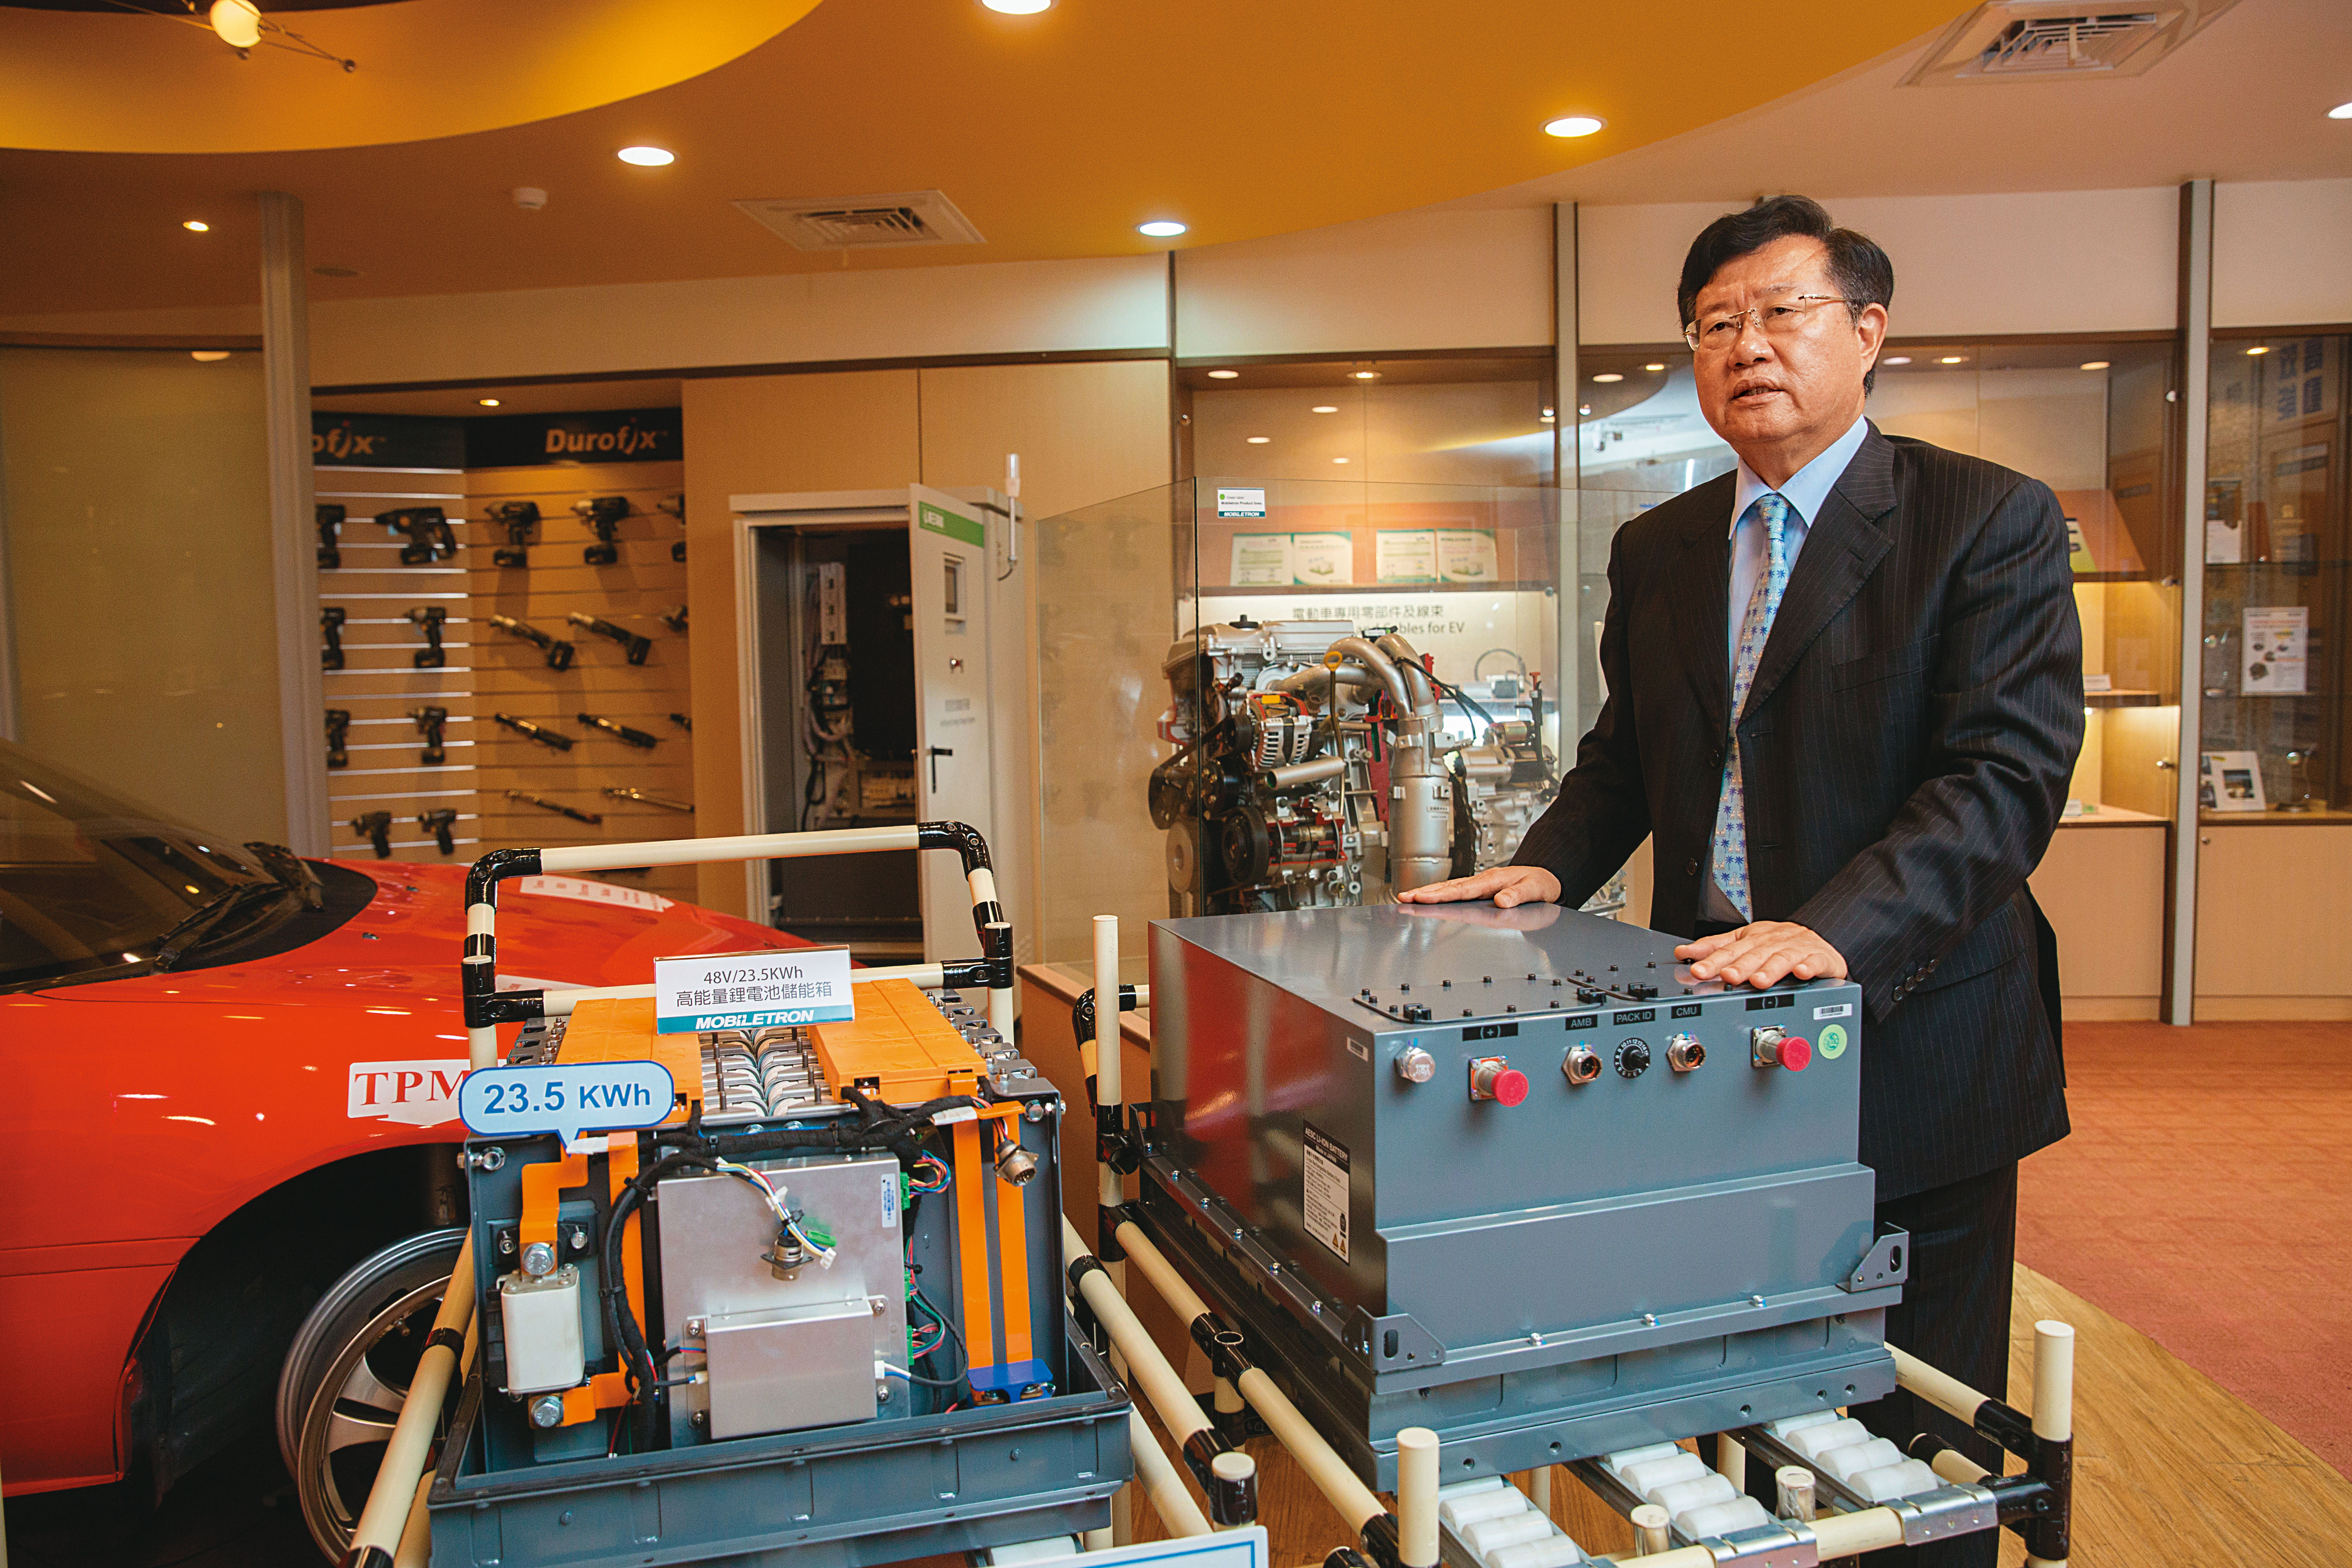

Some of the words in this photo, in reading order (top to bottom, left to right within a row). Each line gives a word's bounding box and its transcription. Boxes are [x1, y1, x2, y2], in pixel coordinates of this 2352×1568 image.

[1428, 621, 1445, 634] for
[1449, 621, 1465, 634] EV
[703, 965, 803, 984] 48V/23.5KWh
[676, 981, 832, 1007] 高能量鋰電池儲能箱
[696, 1010, 814, 1029] MOBILETRON
[1616, 1012, 1640, 1023] PACK
[1642, 1011, 1652, 1020] ID
[1676, 1007, 1697, 1016] CMU
[1571, 1018, 1592, 1027] AMB
[484, 1081, 565, 1115] 23.5
[579, 1083, 651, 1109] KWh
[1305, 1127, 1316, 1140] AESC
[1316, 1134, 1329, 1149] LI-ION
[1330, 1143, 1348, 1161] BATTERY
